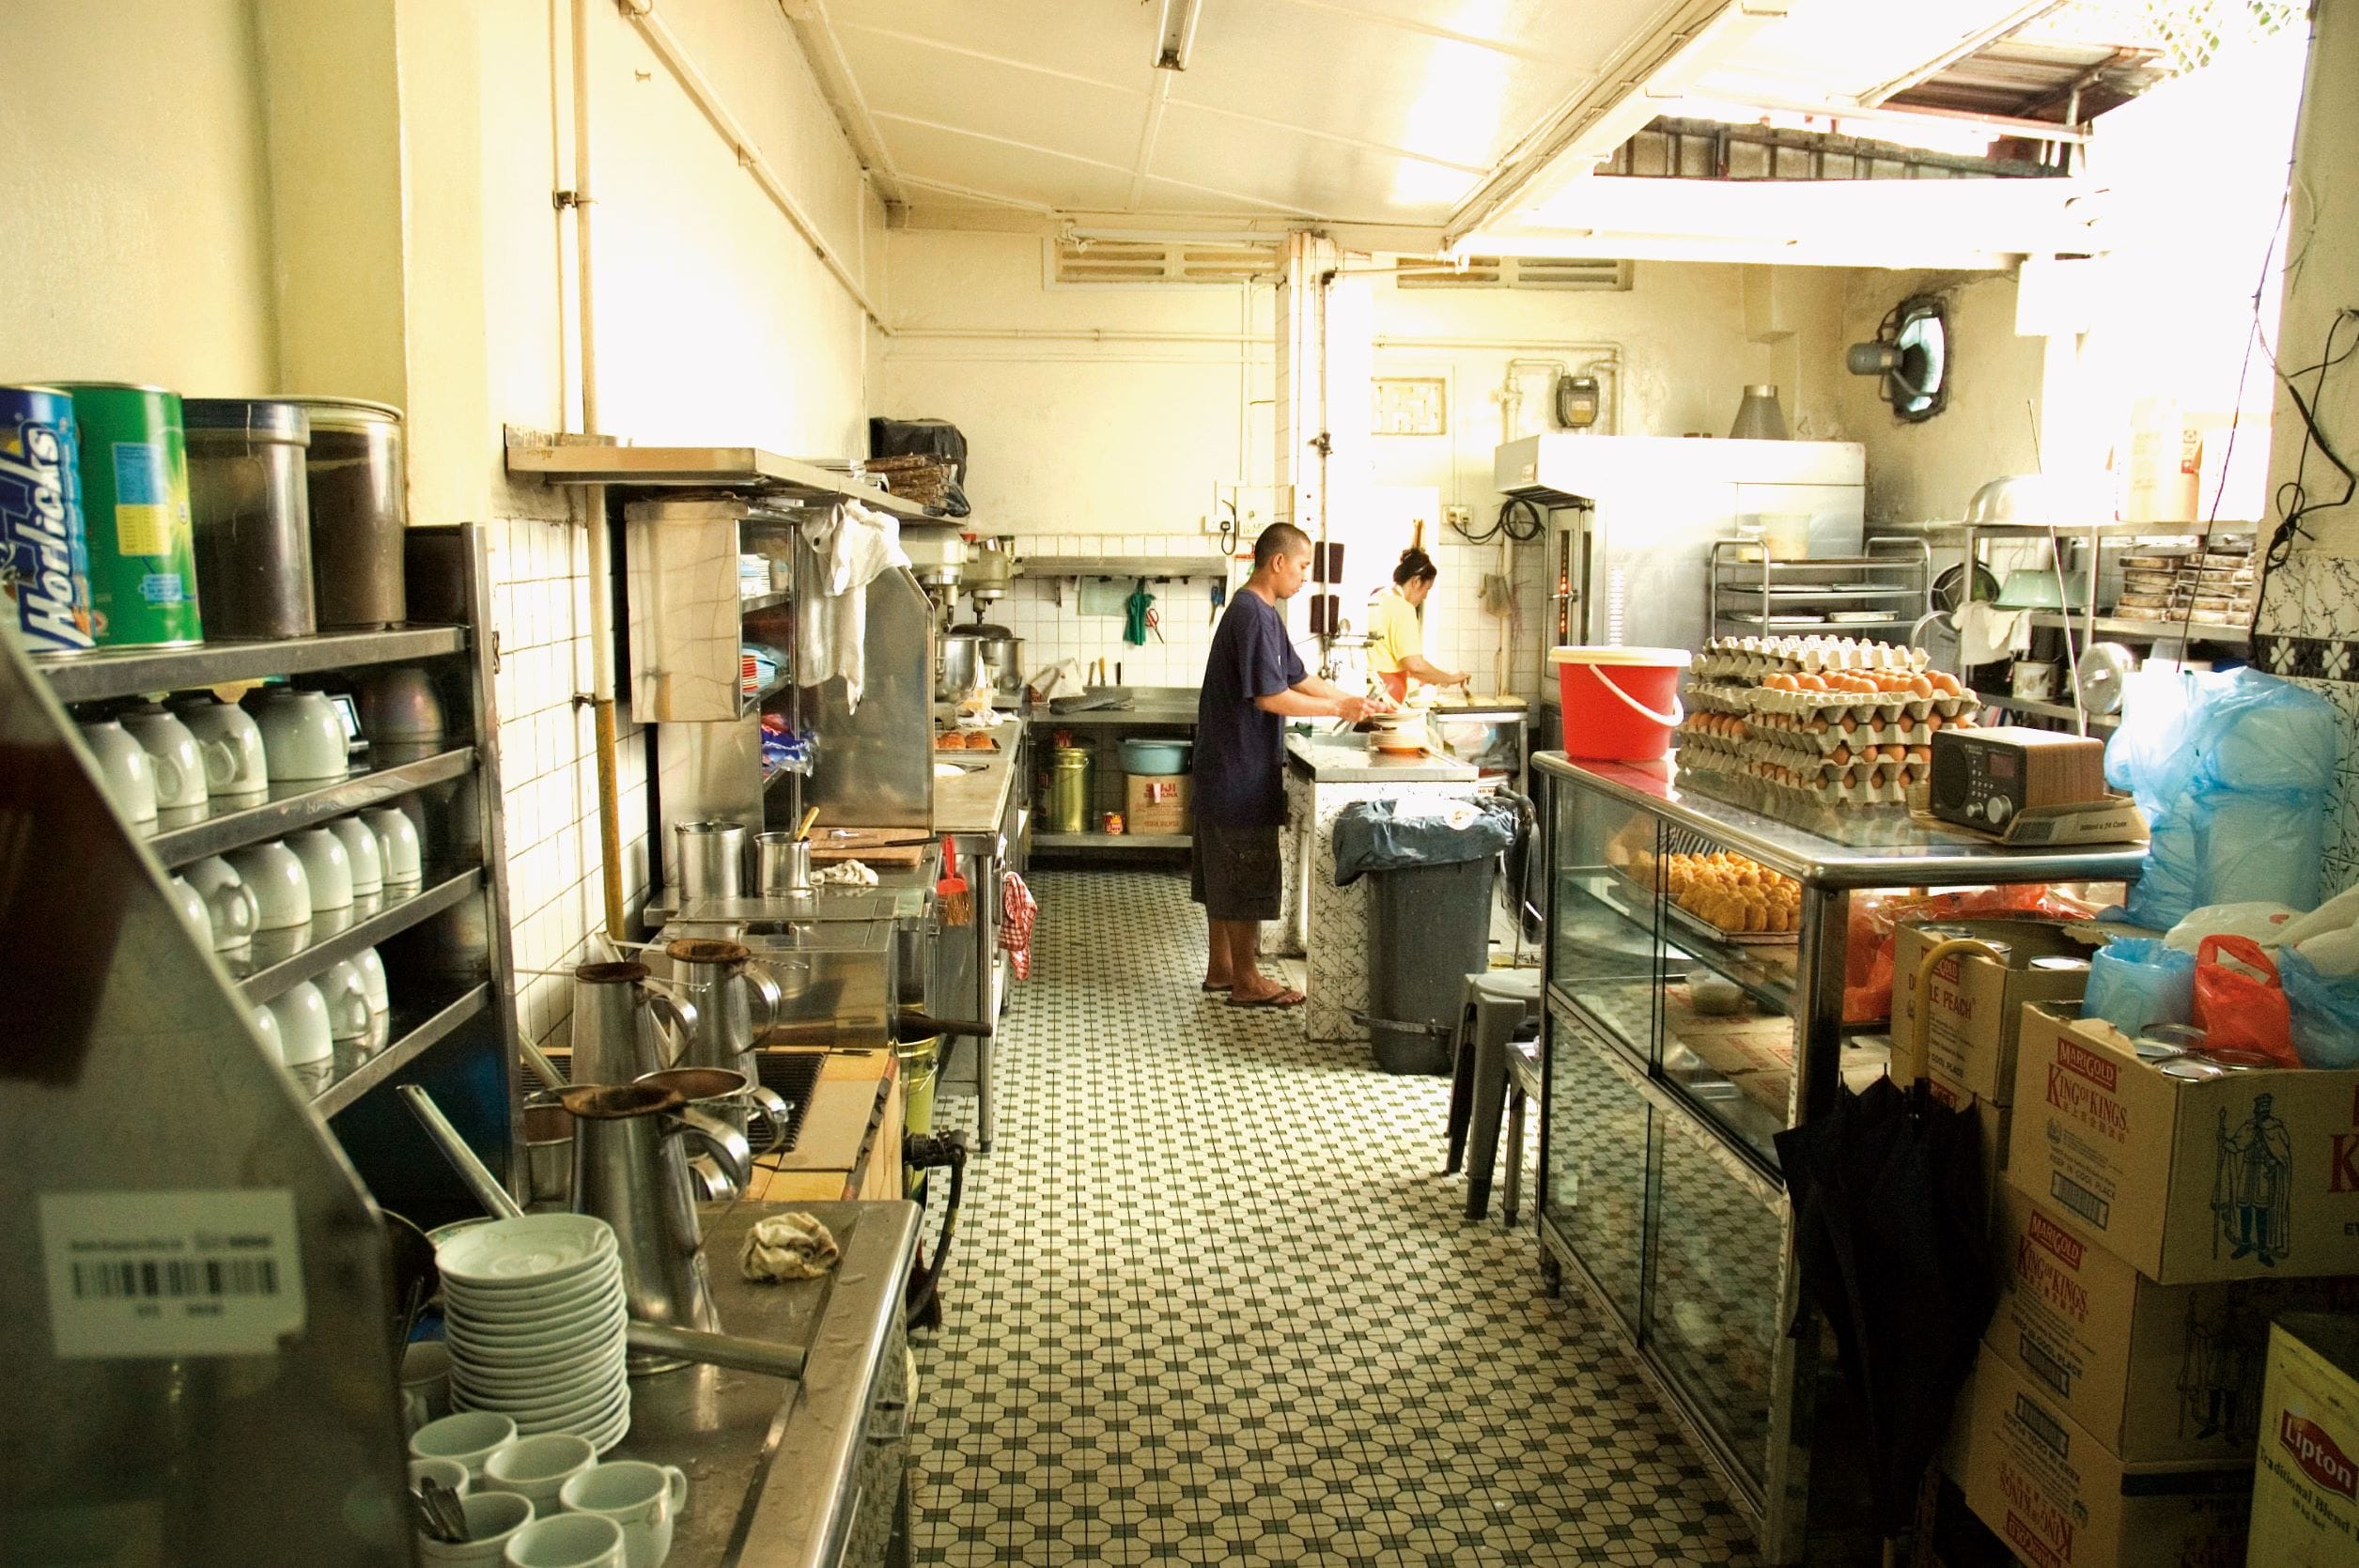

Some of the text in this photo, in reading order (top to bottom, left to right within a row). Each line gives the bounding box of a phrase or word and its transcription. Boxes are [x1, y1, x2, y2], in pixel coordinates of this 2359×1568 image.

[0, 427, 97, 648] Horlicks
[1943, 991, 1972, 1021] PEACH
[2058, 1041, 2115, 1082] MARIGOLD
[2046, 1063, 2080, 1110] KING
[2089, 1091, 2127, 1131] KINGS
[2030, 1214, 2079, 1261] MARIGOLD
[2052, 1268, 2087, 1313] KINGS
[2285, 1417, 2352, 1489] Lipton
[2259, 1444, 2350, 1534] Traditional Blend
